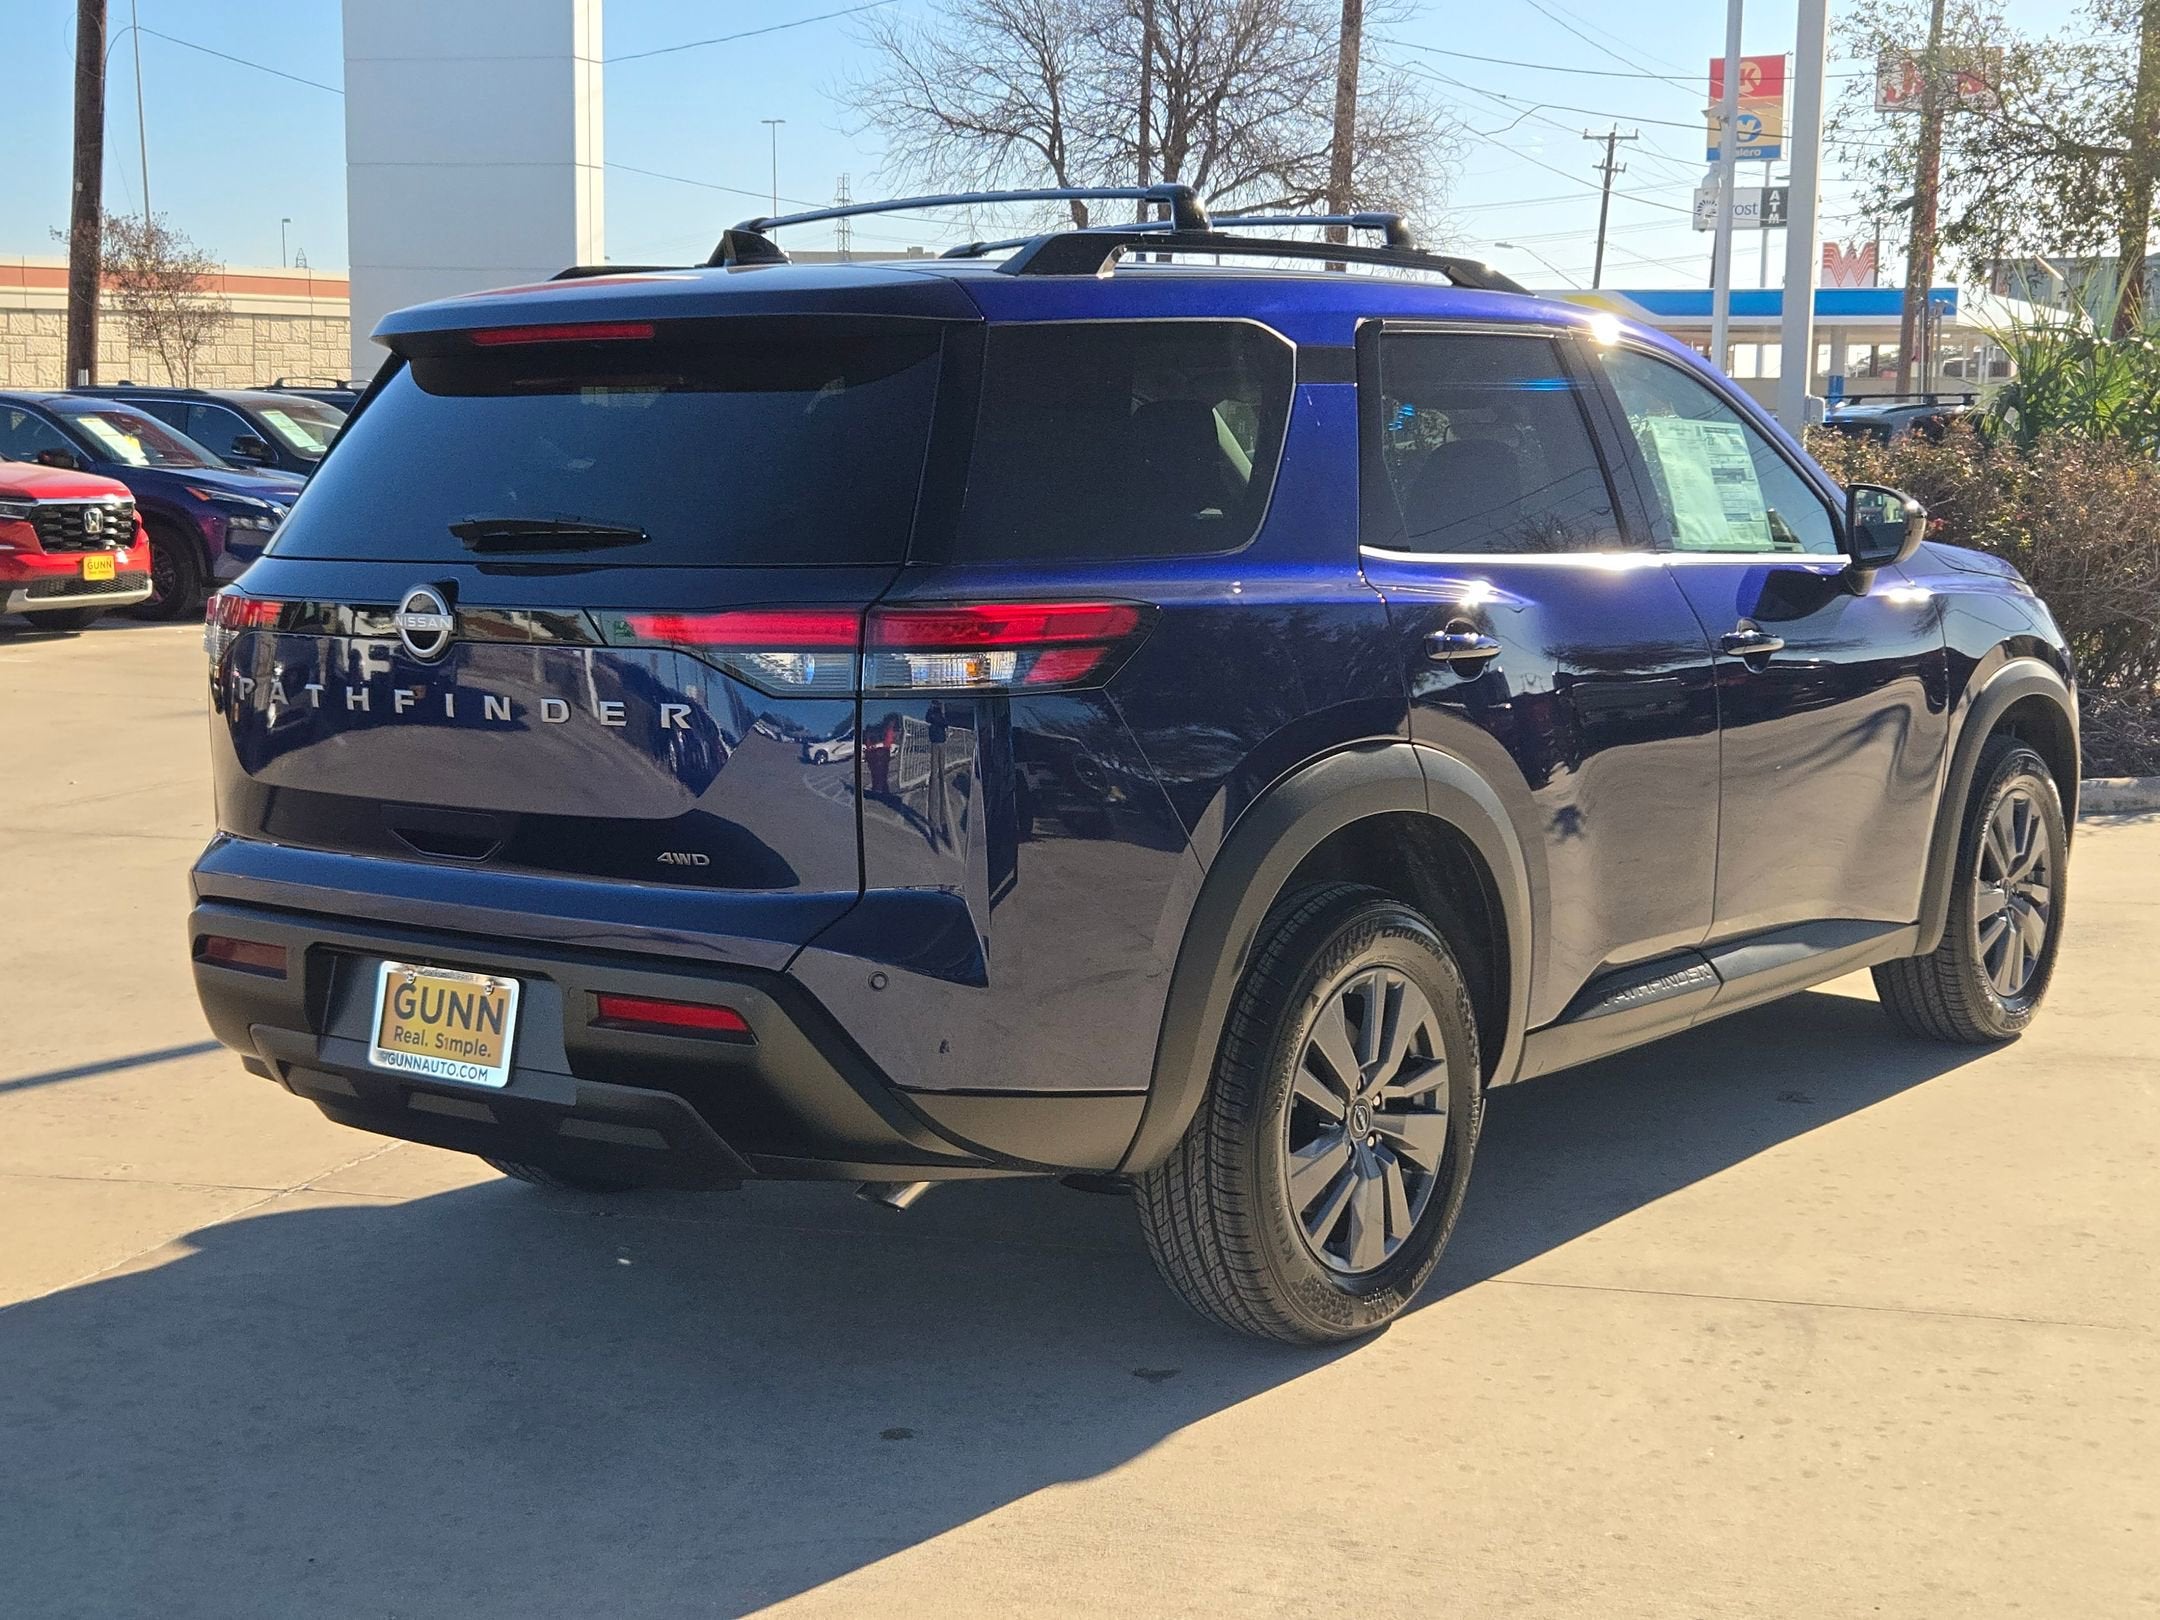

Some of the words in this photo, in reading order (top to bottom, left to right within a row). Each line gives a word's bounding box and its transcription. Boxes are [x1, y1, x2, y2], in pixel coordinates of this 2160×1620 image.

[1736, 148, 1761, 157] lero
[1733, 202, 1758, 216] ost
[1768, 190, 1781, 224] ATM
[87, 560, 112, 570] GUNN
[394, 614, 452, 629] NISSAN
[239, 676, 693, 730] PATHFINDER
[656, 851, 711, 867] 4WD
[1601, 962, 1712, 1007] PATHFINDER
[393, 982, 505, 1035] GUNN
[394, 1025, 429, 1048] Real.
[387, 1052, 489, 1082] GUNNAUTO.COM
